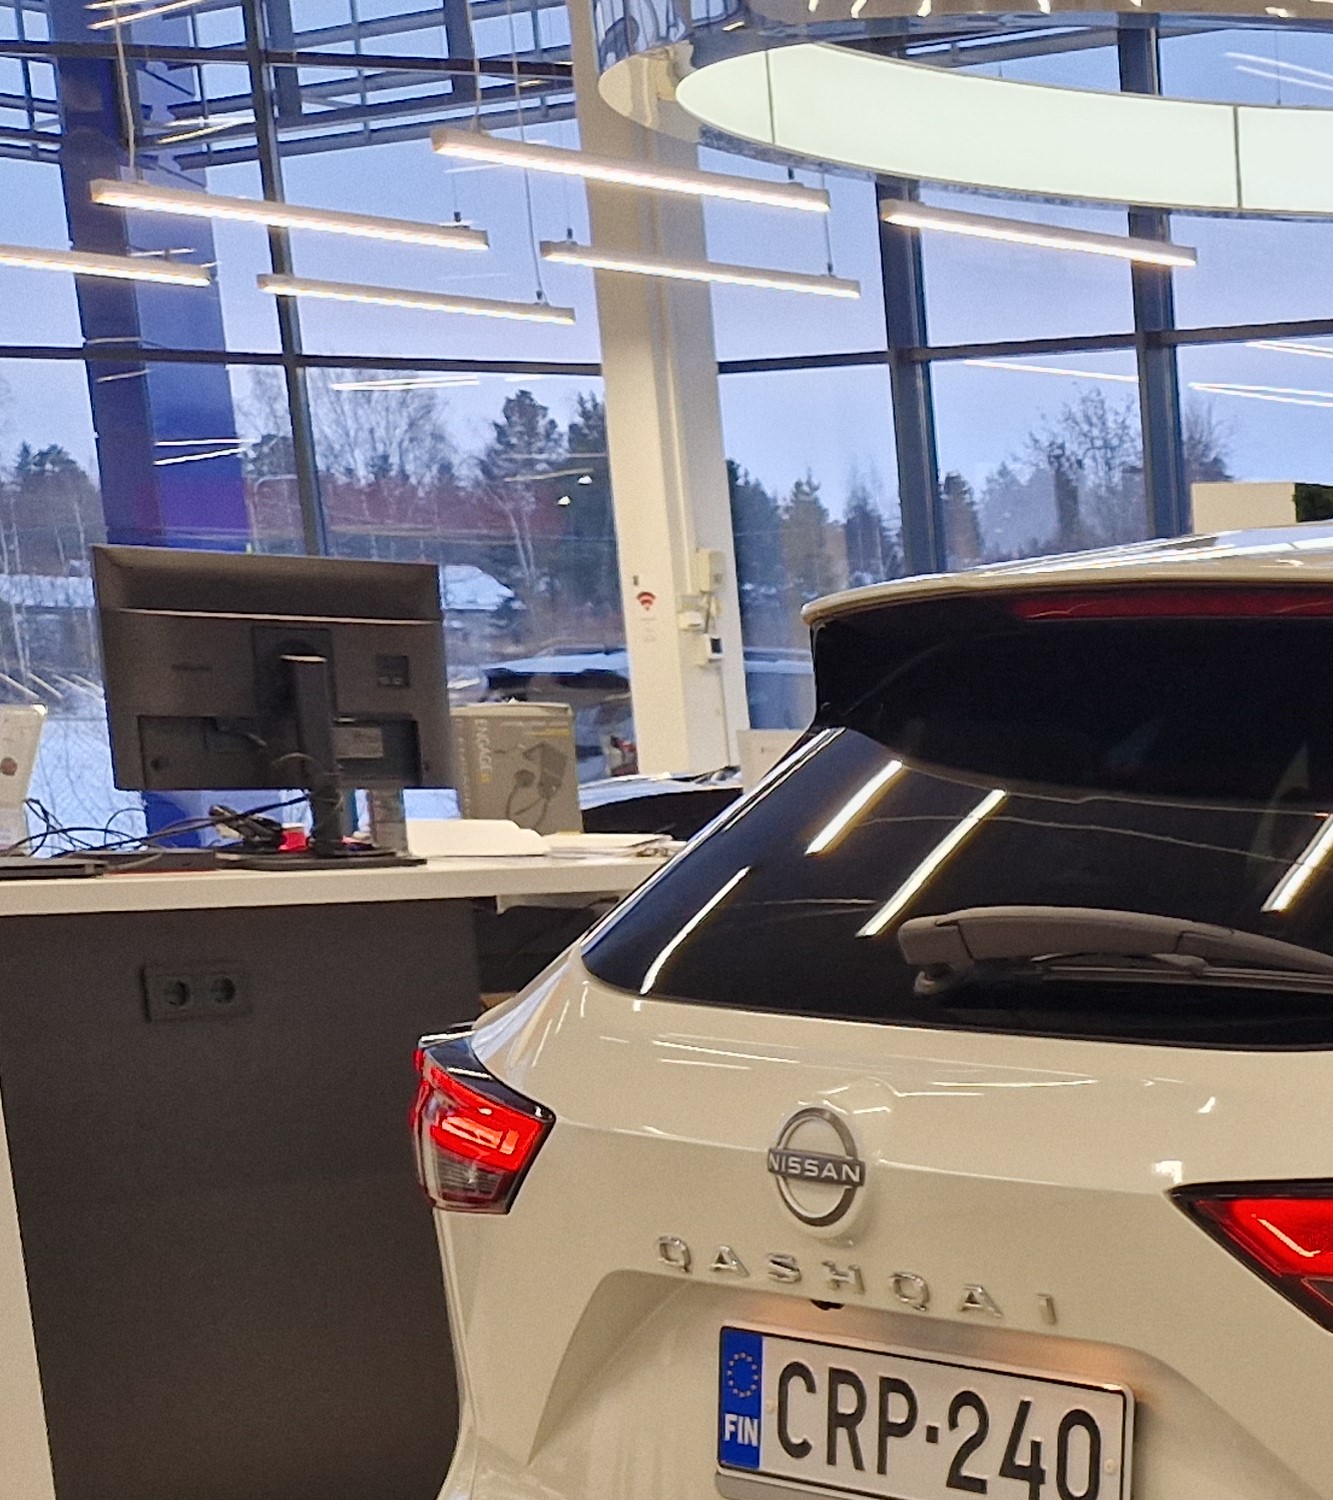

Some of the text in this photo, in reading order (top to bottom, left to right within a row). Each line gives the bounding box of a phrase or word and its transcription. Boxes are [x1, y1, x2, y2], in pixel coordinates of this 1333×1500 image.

[769, 1152, 861, 1184] NISSAN
[655, 1236, 1057, 1324] QASHQAI
[724, 1413, 759, 1448] FIN
